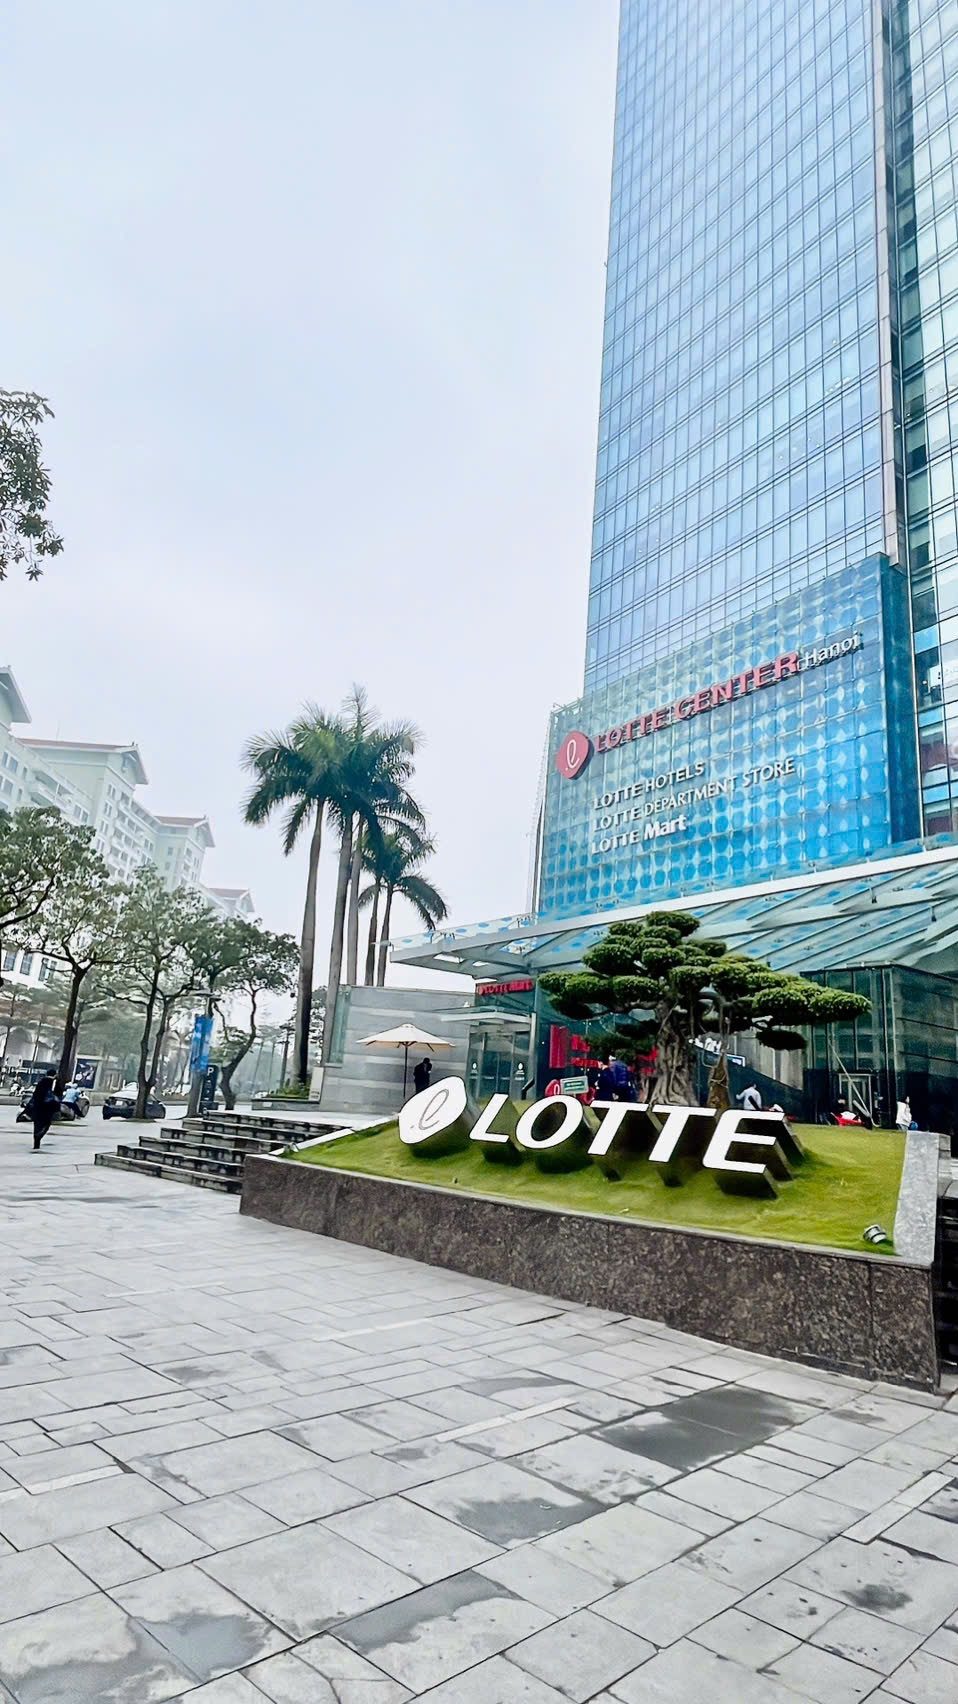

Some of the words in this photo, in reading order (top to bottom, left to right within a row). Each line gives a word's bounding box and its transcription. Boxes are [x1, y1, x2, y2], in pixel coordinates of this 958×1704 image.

[595, 706, 670, 752] LOTTE
[675, 650, 799, 721] CENTER
[804, 630, 860, 668] Hanoi
[592, 807, 641, 832] LOTTE
[643, 776, 738, 817] DEPARTMENT
[742, 757, 796, 788] STORE
[593, 782, 644, 809] LOTTE
[645, 761, 705, 793] HOTELS
[591, 830, 640, 855] LOTTE
[643, 814, 688, 841] Mart
[469, 1093, 785, 1174] LOTTE
